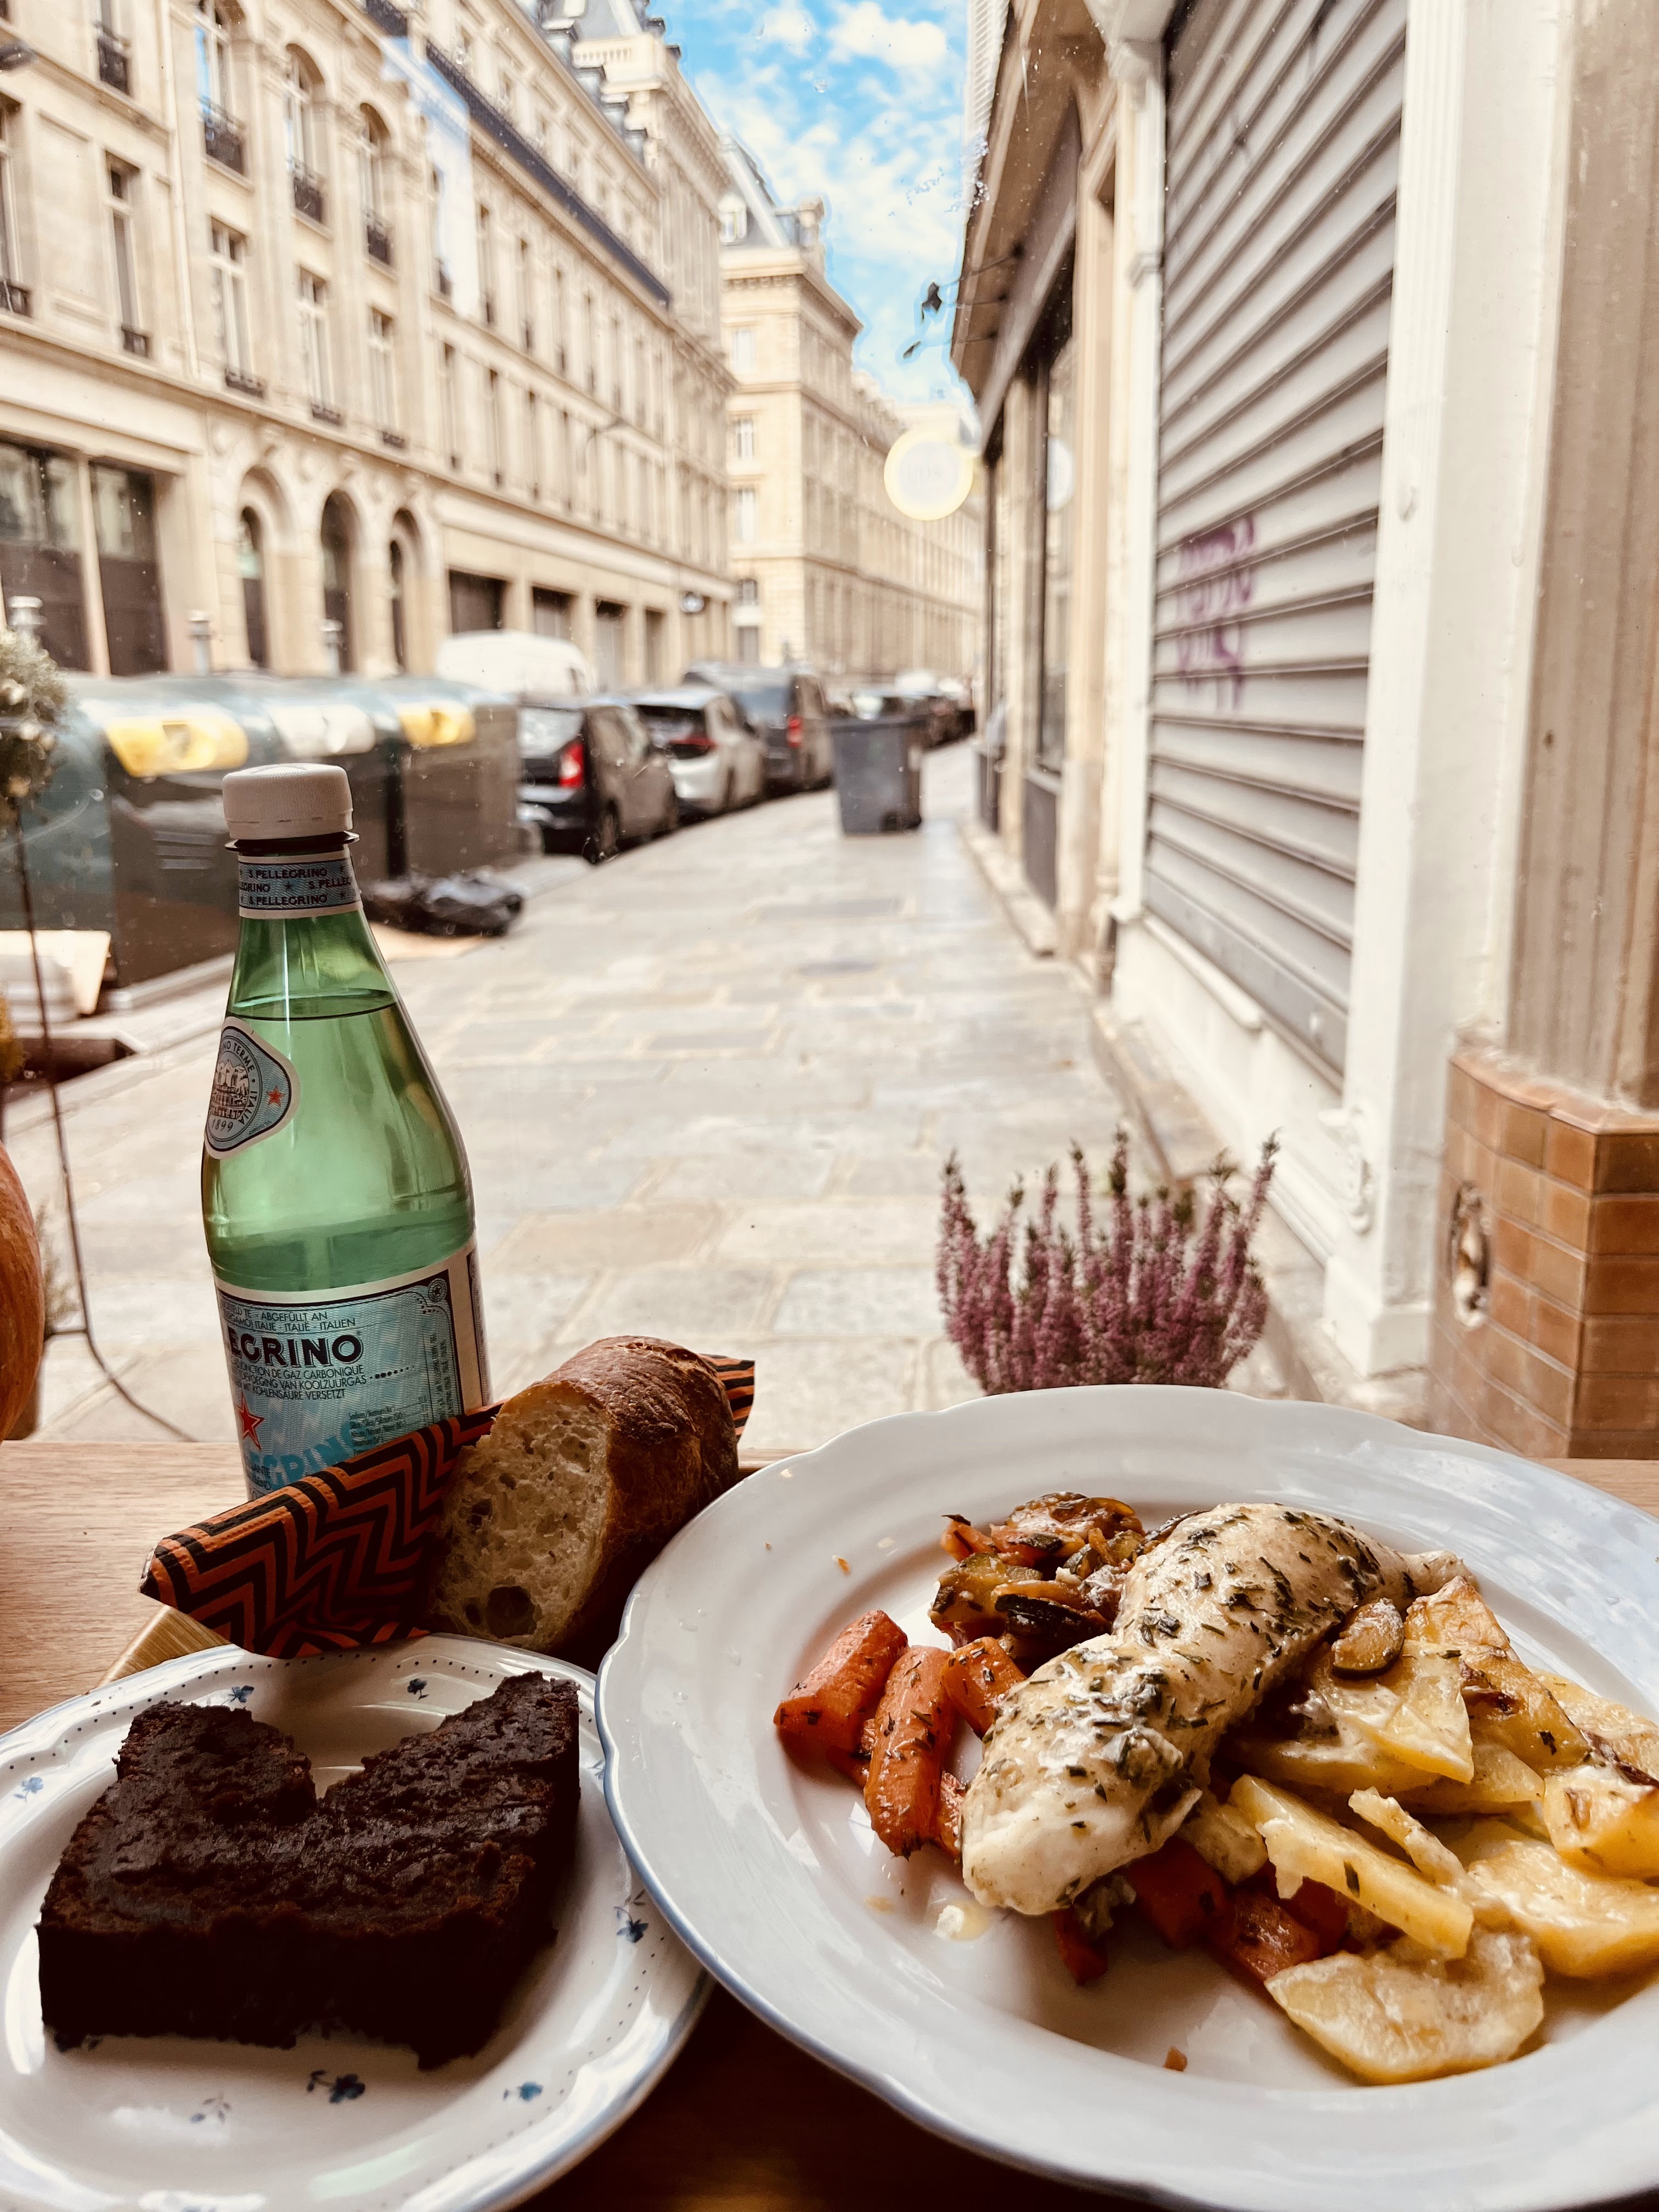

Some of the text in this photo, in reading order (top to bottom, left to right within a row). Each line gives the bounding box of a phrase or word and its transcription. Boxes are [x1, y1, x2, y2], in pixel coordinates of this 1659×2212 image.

[234, 1042, 255, 1073] TERME
[238, 1091, 258, 1125] ITALIA
[212, 1118, 234, 1132] 1899
[261, 1311, 307, 1322] ABGEFÜLLT
[312, 1312, 327, 1321] AN
[320, 1318, 356, 1331] ITALIEN
[272, 1369, 281, 1378] DE
[284, 1370, 301, 1379] GAZ
[304, 1365, 364, 1379] CARBONIQUE
[280, 1380, 297, 1390] VAN
[300, 1375, 367, 1390] KOOLZUURGAS
